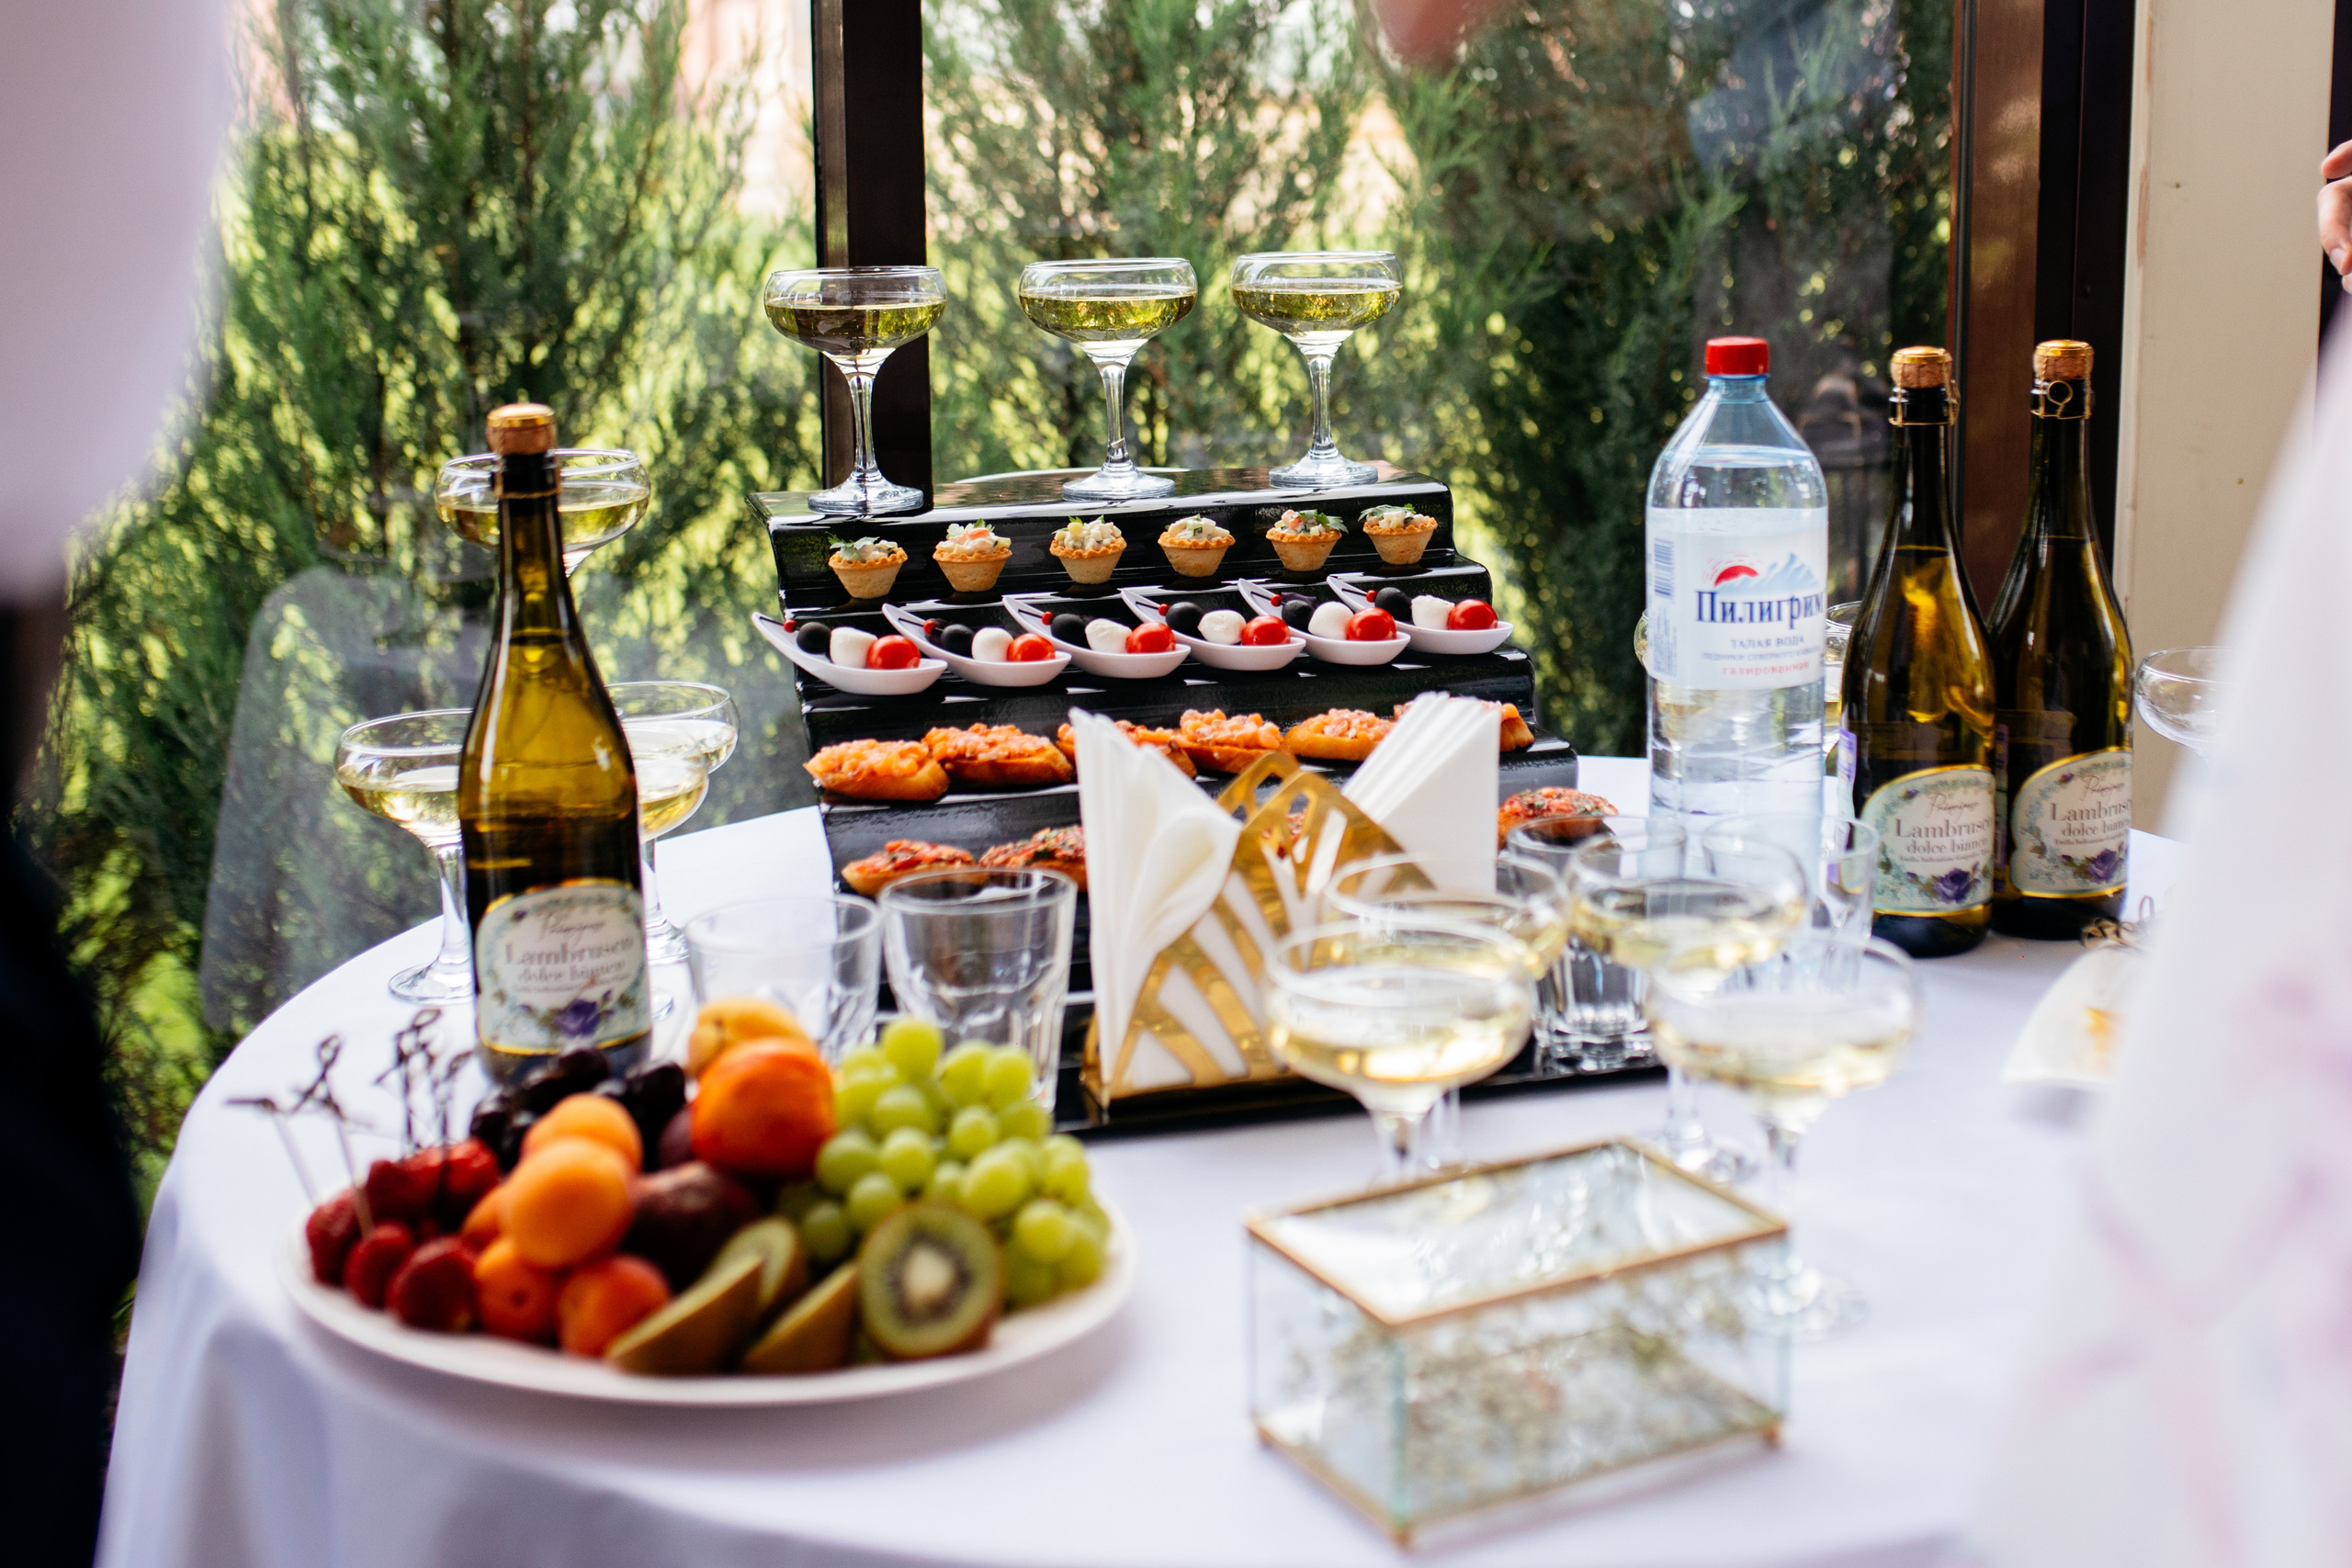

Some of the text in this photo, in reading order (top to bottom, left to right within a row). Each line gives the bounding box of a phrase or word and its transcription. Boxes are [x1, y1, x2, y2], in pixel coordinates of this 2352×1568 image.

[1695, 590, 1824, 630] Пилигрим
[1731, 636, 1805, 649] ТАЛАЯ ВОДА
[1723, 661, 1809, 676] газированная
[2051, 799, 2132, 821] Lambrusc
[1895, 817, 1993, 838] Lambrusco
[2062, 822, 2099, 837] dolce
[1906, 840, 1947, 854] dolce
[1951, 838, 1988, 853] bianco
